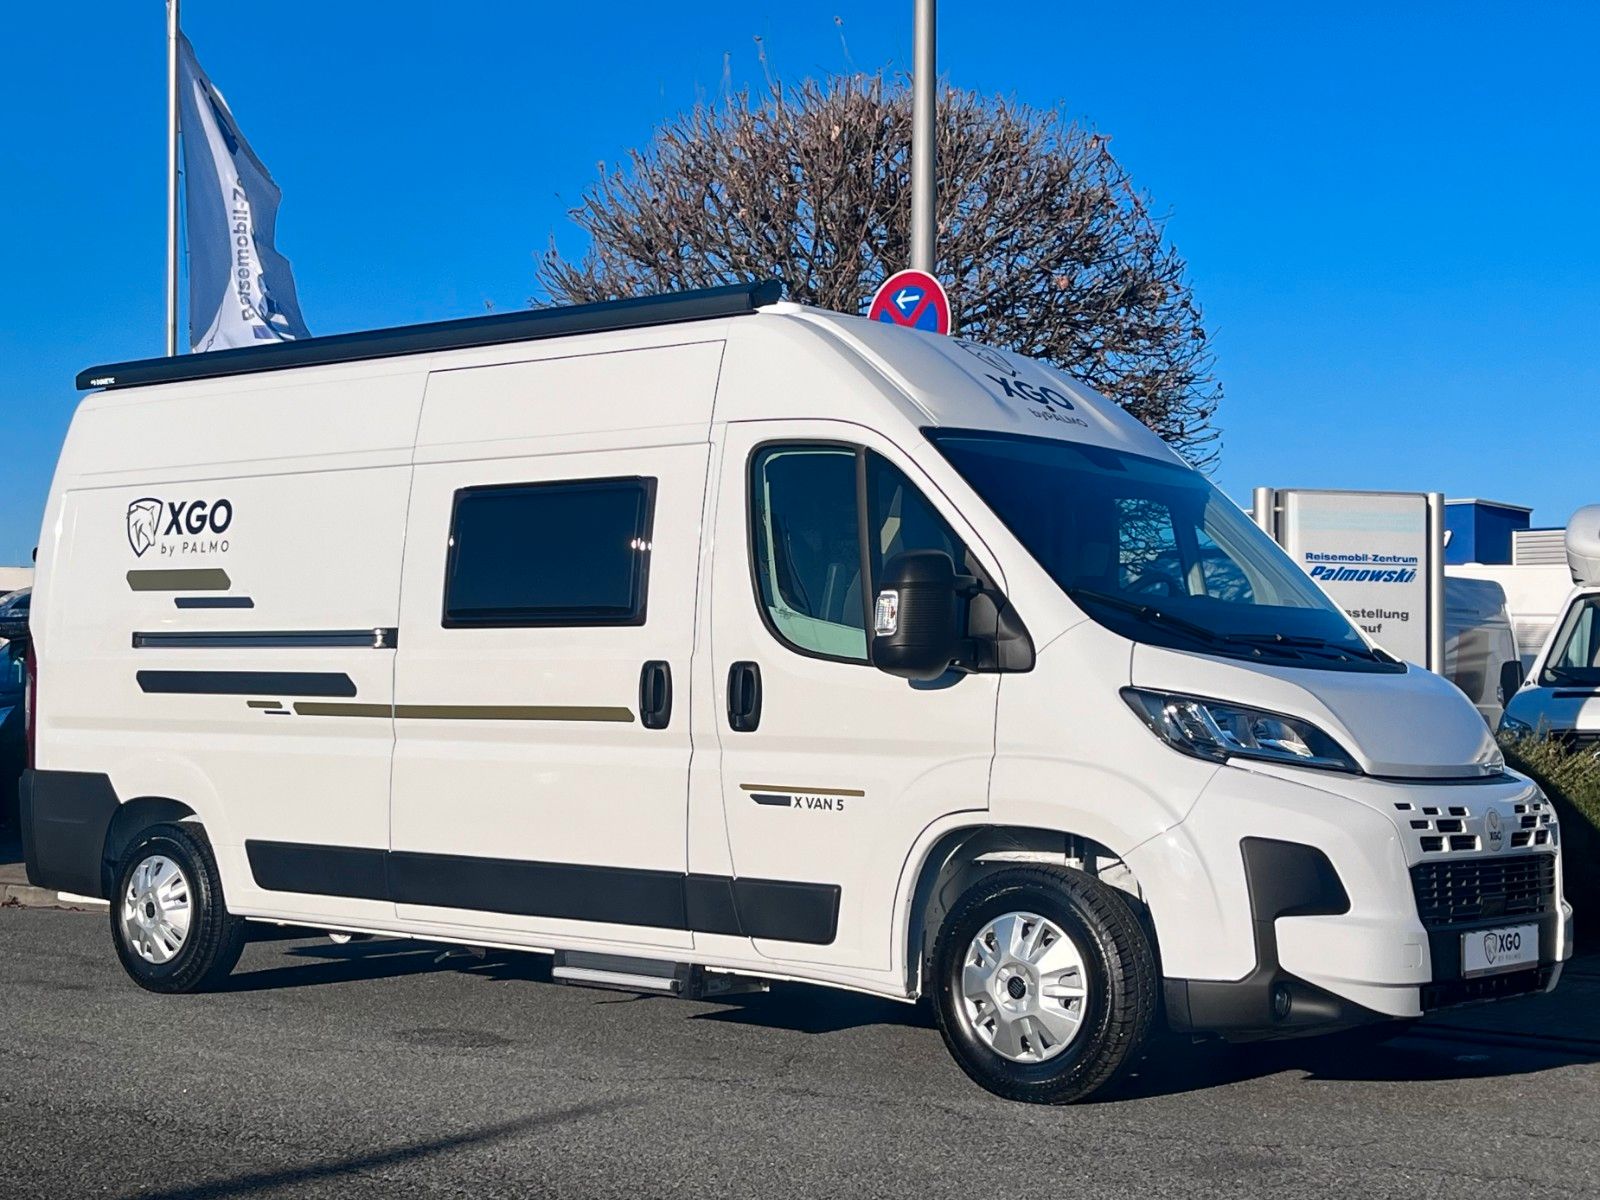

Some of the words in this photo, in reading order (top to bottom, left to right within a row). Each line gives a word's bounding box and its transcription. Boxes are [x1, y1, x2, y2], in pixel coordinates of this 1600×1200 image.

[984, 373, 1075, 411] XGO
[163, 498, 233, 535] XGO
[160, 543, 175, 557] by
[182, 540, 230, 553] PALMO
[1305, 552, 1418, 563] Reisemobil-Zentrum
[1310, 566, 1416, 583] Palmowski
[794, 796, 802, 808] X
[806, 797, 833, 811] VAN
[836, 799, 844, 811] 5
[1498, 932, 1521, 953] XGO
